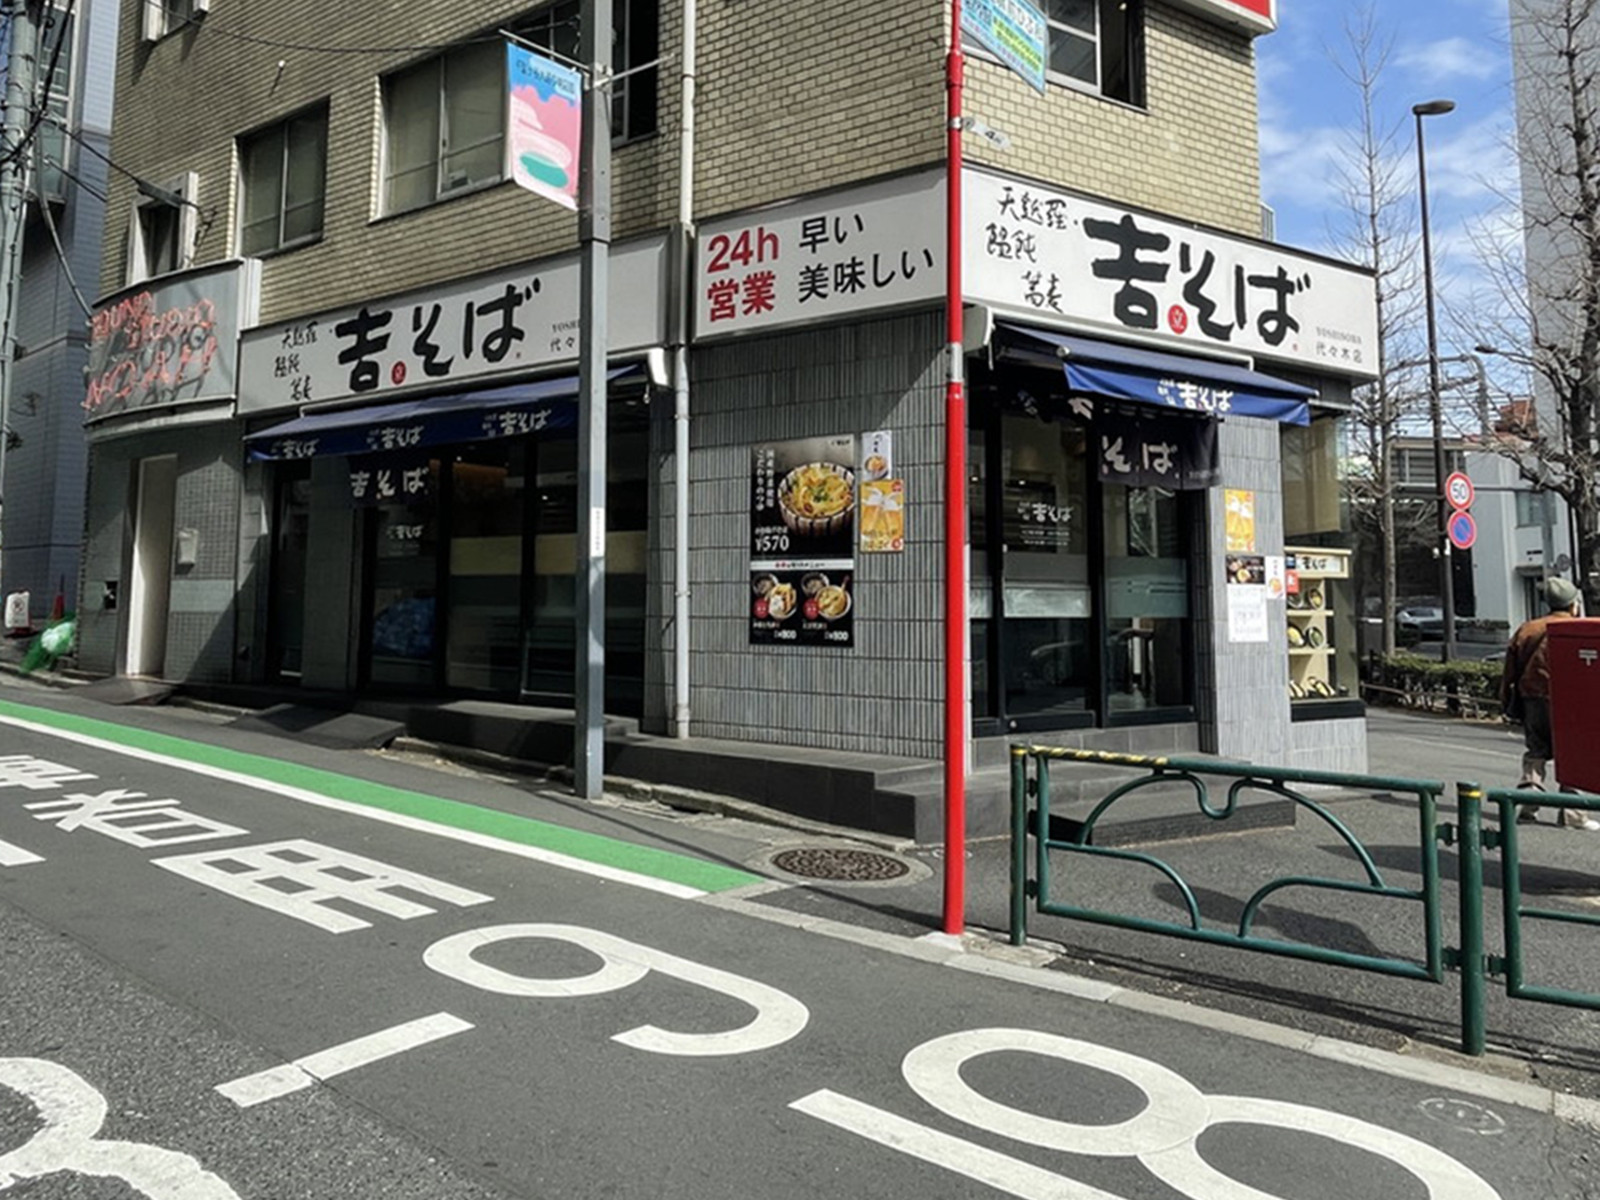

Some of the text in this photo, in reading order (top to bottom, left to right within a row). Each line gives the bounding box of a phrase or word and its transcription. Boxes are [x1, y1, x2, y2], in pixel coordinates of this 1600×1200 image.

[707, 227, 779, 273] 24h
[799, 214, 864, 254] 早い
[798, 249, 934, 303] 美味しい
[1083, 214, 1311, 347] 吉そば
[707, 270, 776, 323] 営業
[335, 278, 541, 392] 吉そば
[1177, 382, 1234, 413] 吉そば
[381, 425, 425, 448] 吉そば
[499, 409, 552, 434] 吉そば
[1102, 435, 1179, 475] そば
[349, 467, 428, 499] 吉そば
[1452, 483, 1467, 500] 50
